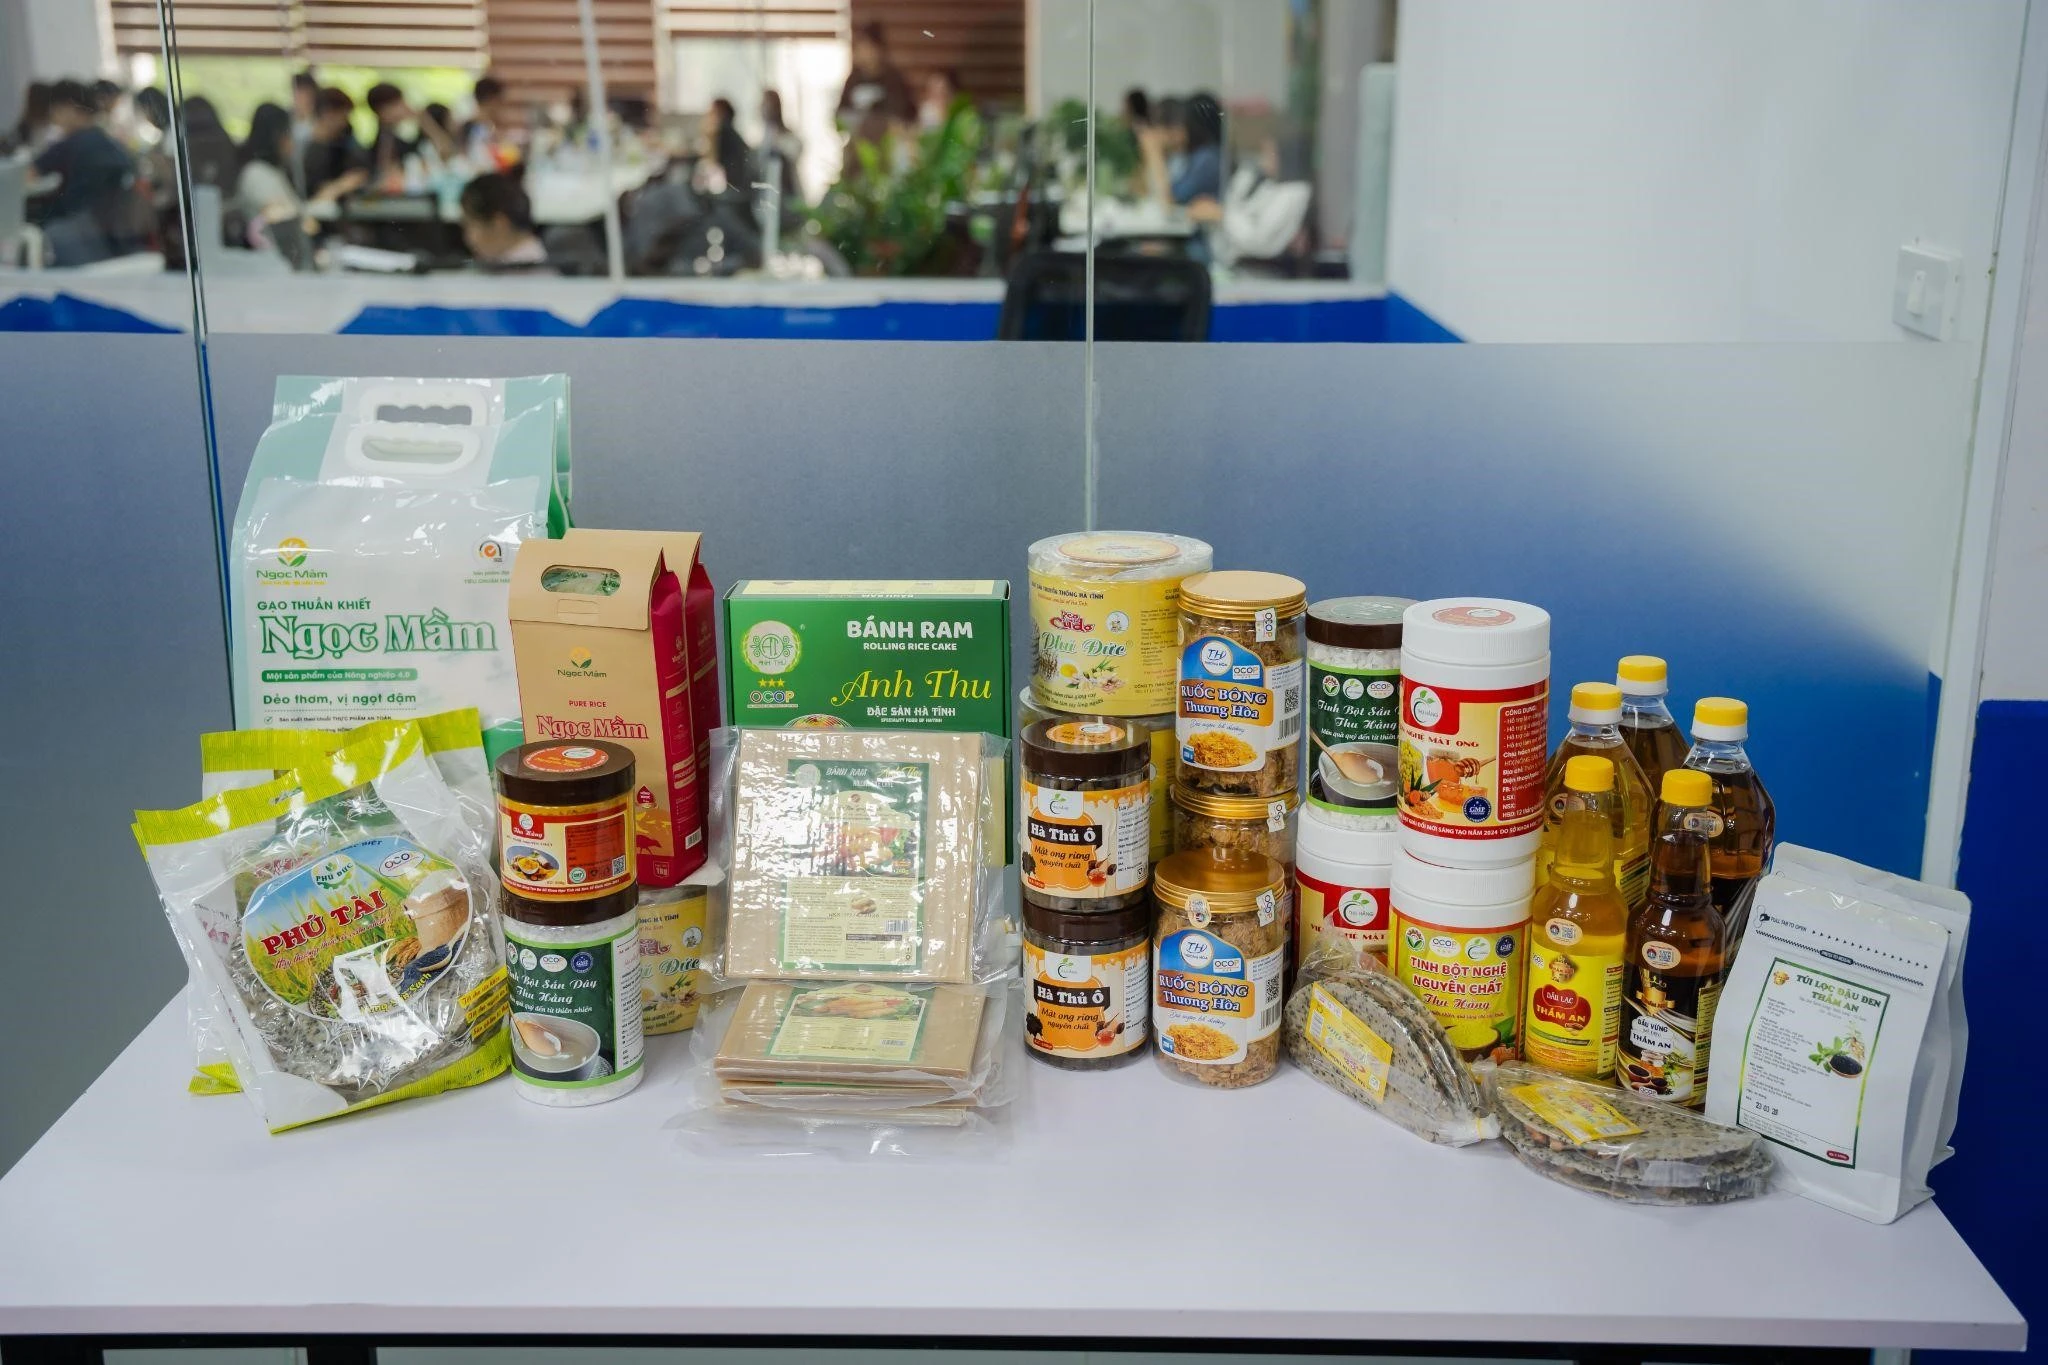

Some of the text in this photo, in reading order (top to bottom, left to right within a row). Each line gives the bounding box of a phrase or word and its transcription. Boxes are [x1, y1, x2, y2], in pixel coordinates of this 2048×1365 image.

[257, 597, 372, 613] GẠO THUẨN KHIẾT
[259, 606, 499, 660] Ngọc Mầm
[847, 614, 974, 639] BÁNH RAM
[863, 642, 958, 651] ROLLING RICE CAKE
[327, 671, 343, 680] của
[830, 669, 992, 707] Anh Thu
[1180, 681, 1268, 705] RUỐC BÔNG
[263, 692, 417, 706] Dẻo thơm, vị ngọt đậm
[749, 690, 795, 704] OCOP
[866, 704, 956, 717] ĐẶC SẢN HÀ TĨNH
[1184, 700, 1260, 719] Thương Hòa
[1317, 698, 1340, 713] Tinh
[1343, 703, 1365, 717] Bột
[537, 715, 592, 740] Ngọc
[593, 715, 649, 740] Mầm
[1334, 716, 1359, 729] Thu
[1428, 735, 1451, 746] MẬT
[1456, 740, 1479, 748] ONG
[1030, 821, 1097, 843] Hà Thủ Ô
[1438, 825, 1455, 835] SÁNG
[1455, 828, 1467, 836] TẠO
[1467, 827, 1483, 836] NĂM
[1034, 844, 1091, 862] Mật ong rừng
[1039, 857, 1082, 869] nguyên chất
[260, 889, 388, 956] PHÚ TÀI
[1770, 916, 1780, 924] PULL
[1795, 924, 1807, 932] OPEN
[1410, 956, 1508, 978] TINH BỘT NGHỆ
[542, 978, 566, 990] Sắn
[569, 979, 598, 990] Dây
[1158, 972, 1249, 998] RUỐC BÔNG
[1412, 975, 1503, 994] NGUYÊN CHẤT
[1796, 973, 1882, 1008] TÚI LỌC ĐẬU ĐEN
[516, 985, 534, 1001] Thu
[538, 990, 573, 1005] Hằng
[1037, 985, 1105, 1005] Hà Thủ Ô
[1162, 990, 1241, 1012] Thương Hòa
[1423, 992, 1449, 1008] Thu
[1842, 1000, 1860, 1013] AN
[1040, 1007, 1099, 1024] Mật ong rừng
[1568, 1013, 1587, 1024] AN
[1047, 1019, 1090, 1031] nguyên chất
[1650, 1021, 1669, 1033] VỪNG
[1657, 1041, 1671, 1050] AN
